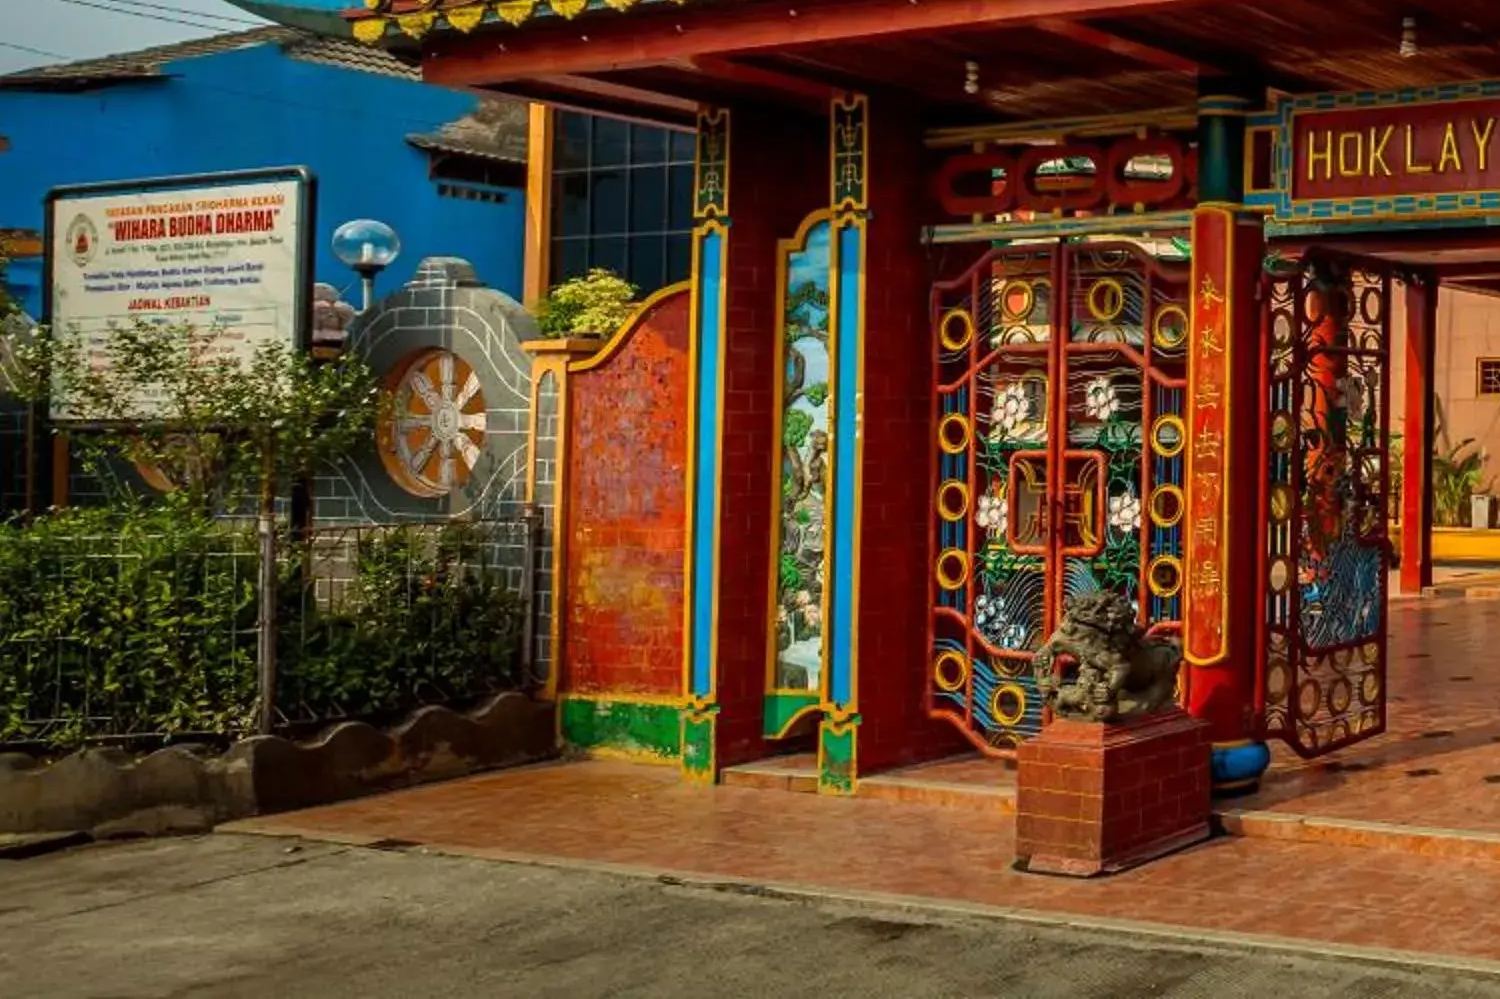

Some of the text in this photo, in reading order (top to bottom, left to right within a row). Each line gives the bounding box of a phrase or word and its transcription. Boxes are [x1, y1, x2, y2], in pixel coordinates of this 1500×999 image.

[1306, 123, 1394, 182] HOK
[1405, 116, 1495, 175] LAY
[169, 213, 212, 239] BUDHA
